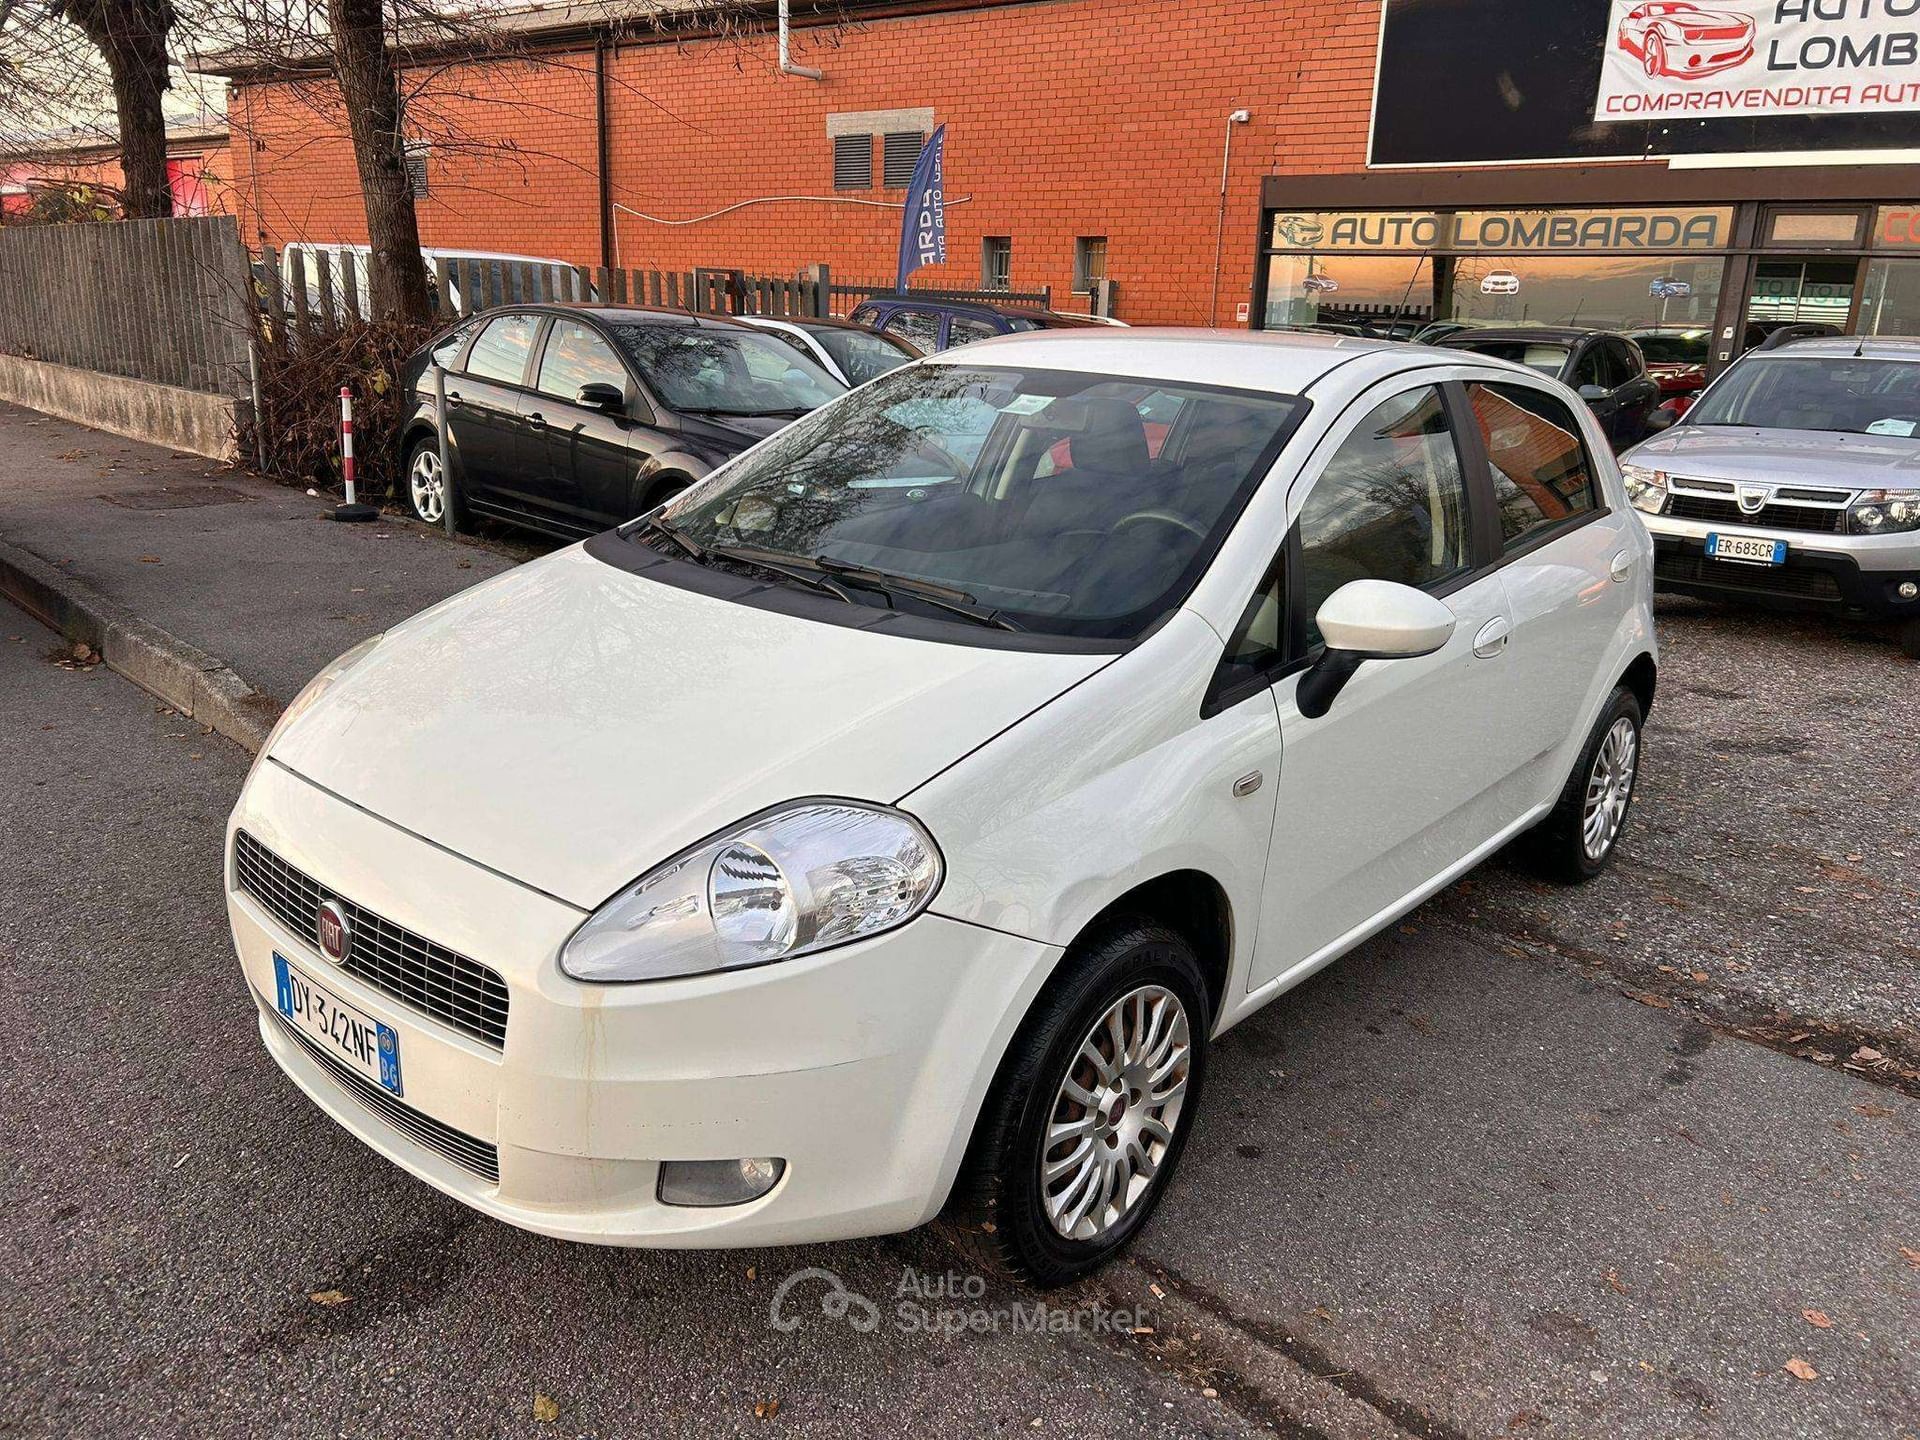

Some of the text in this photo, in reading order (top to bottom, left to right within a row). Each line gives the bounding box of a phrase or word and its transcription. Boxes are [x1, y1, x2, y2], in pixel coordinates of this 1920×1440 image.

[1605, 84, 1852, 114] COMPRAVENDITA
[933, 189, 945, 229] AUTO
[1330, 214, 1718, 247] AUTO LOMBARDA
[321, 916, 341, 951] FIAT
[381, 1055, 398, 1088] BG
